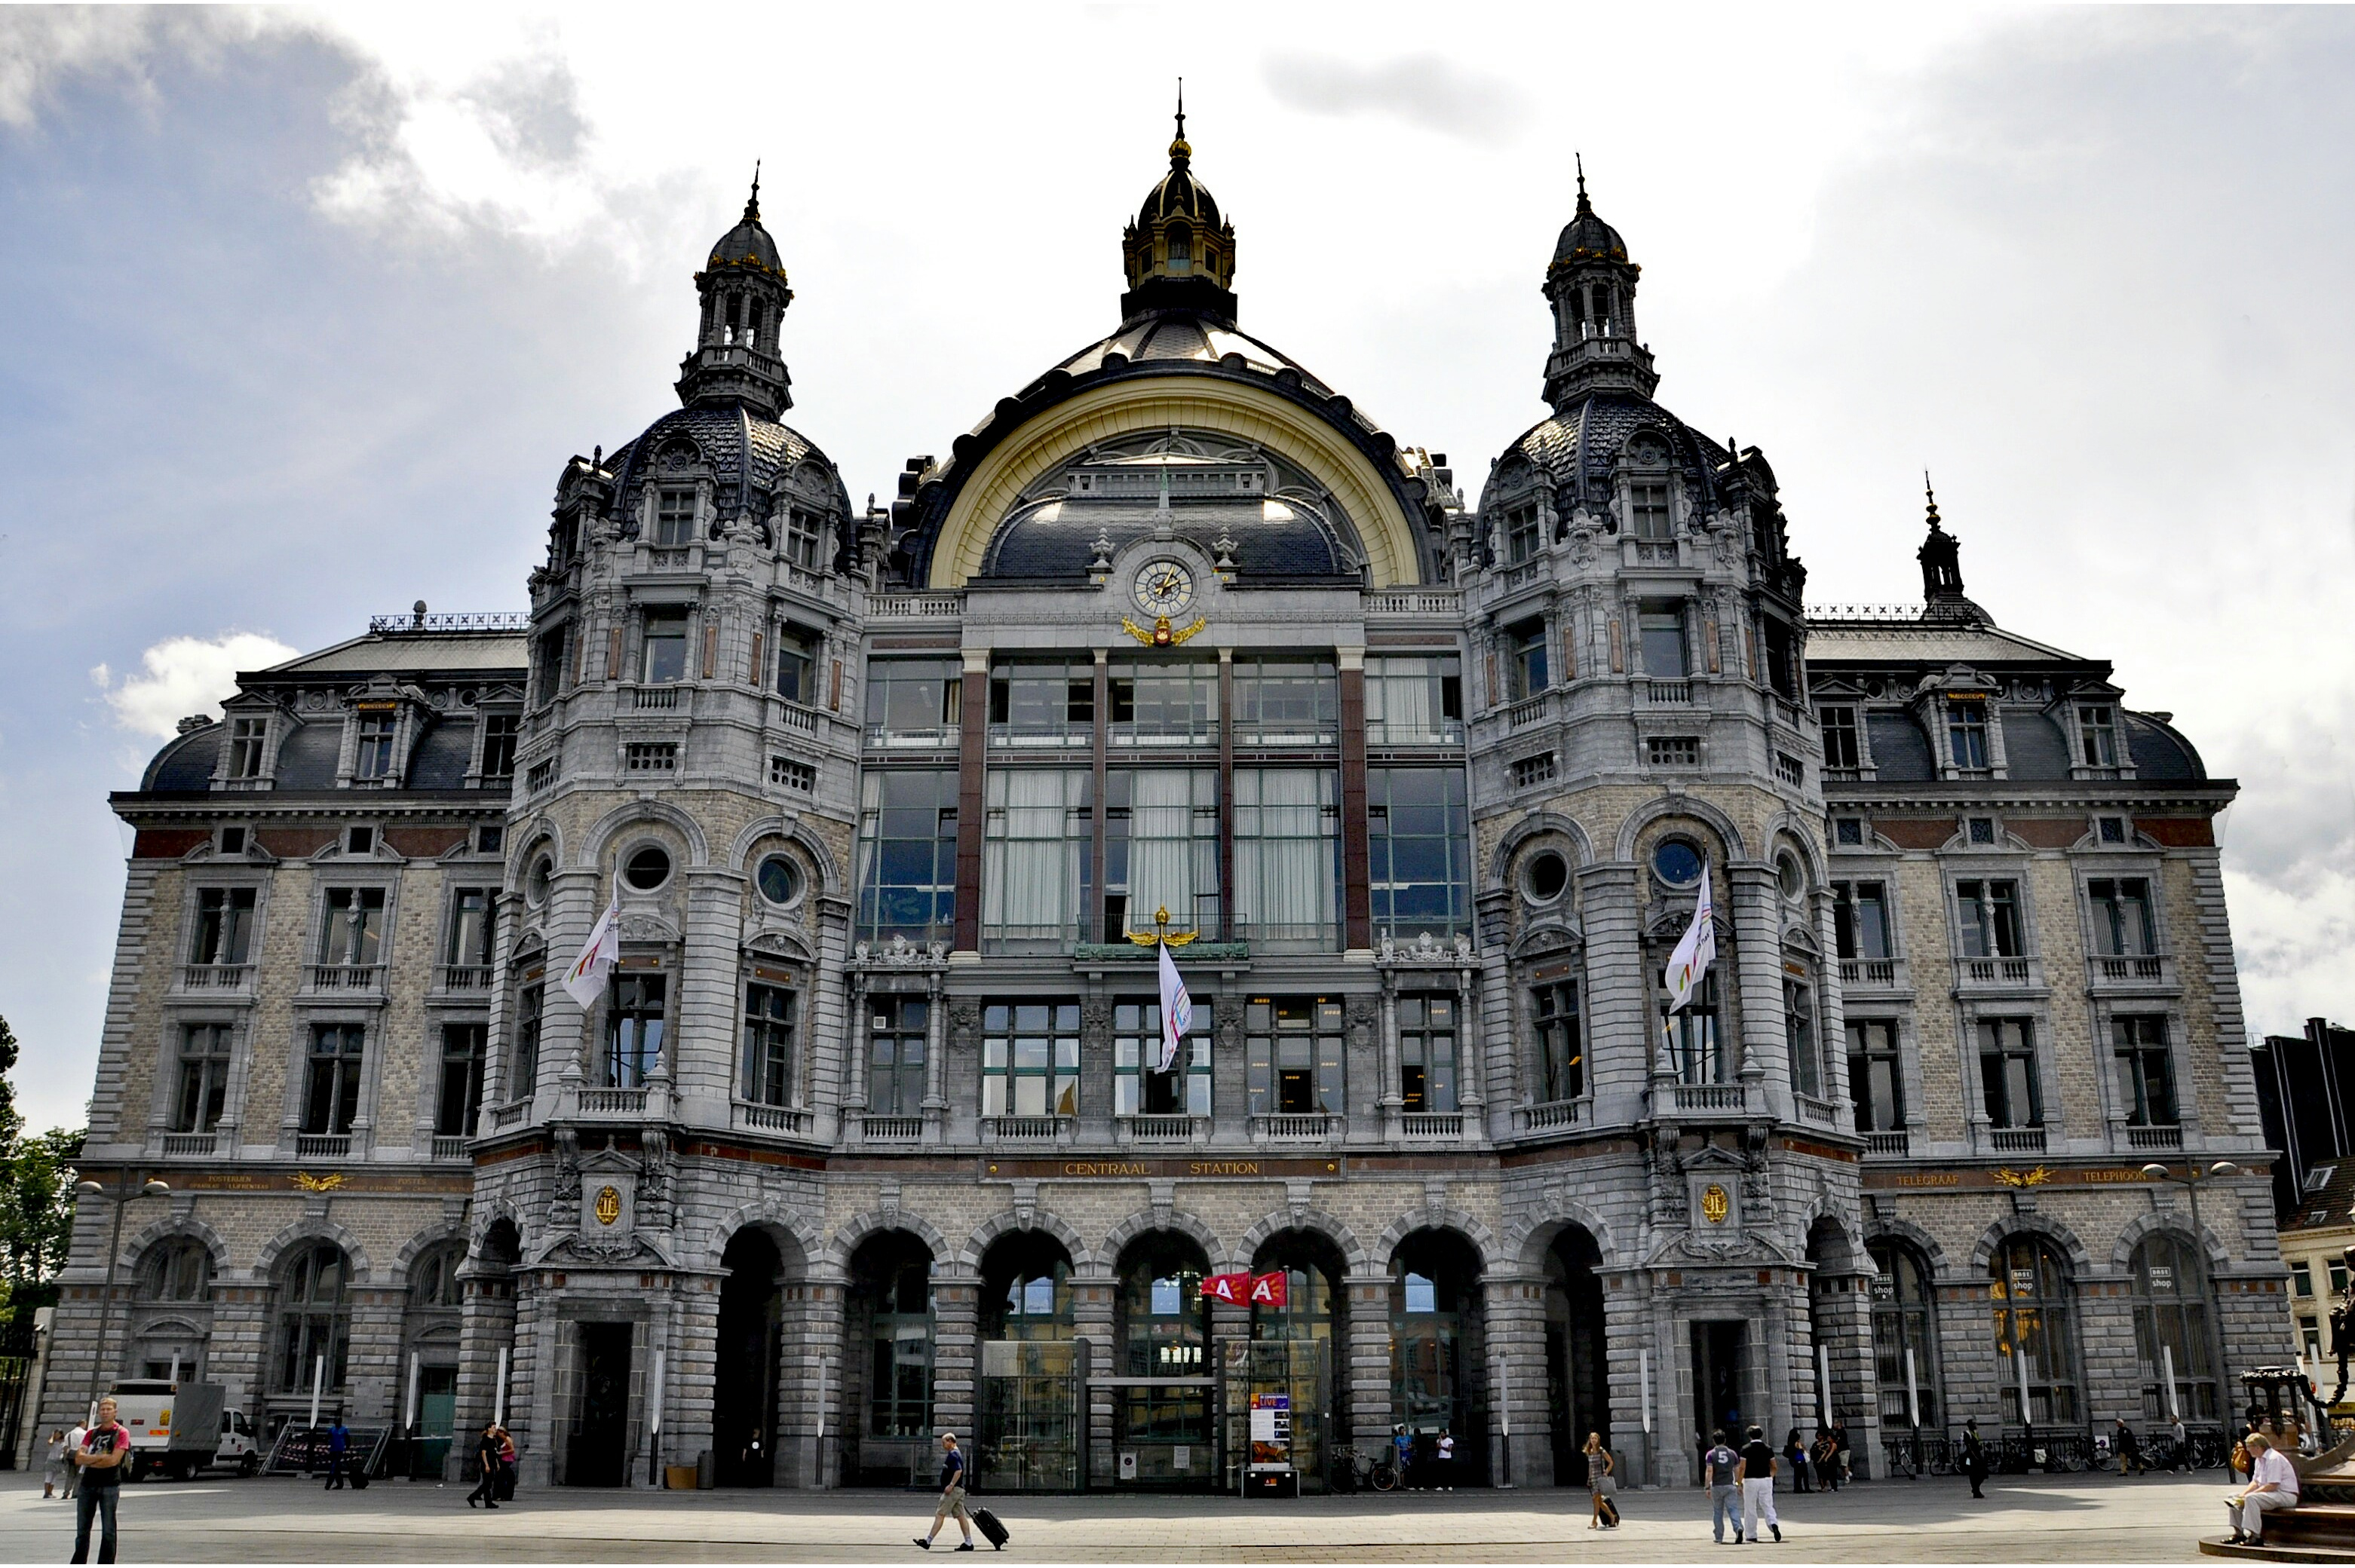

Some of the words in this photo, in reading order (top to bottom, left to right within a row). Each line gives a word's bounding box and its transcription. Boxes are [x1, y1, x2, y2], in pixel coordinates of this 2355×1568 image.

[1065, 1163, 1151, 1175] CENTRAAL
[1190, 1162, 1258, 1174] STATION
[1896, 1175, 1959, 1186] TELEGRAAF
[2083, 1171, 2147, 1181] TELEPHOON
[2013, 1281, 2033, 1291] shop
[2152, 1279, 2172, 1288] shop
[1252, 1280, 1272, 1300] A
[1874, 1285, 1894, 1295] shop
[1718, 1451, 1728, 1464] 5
